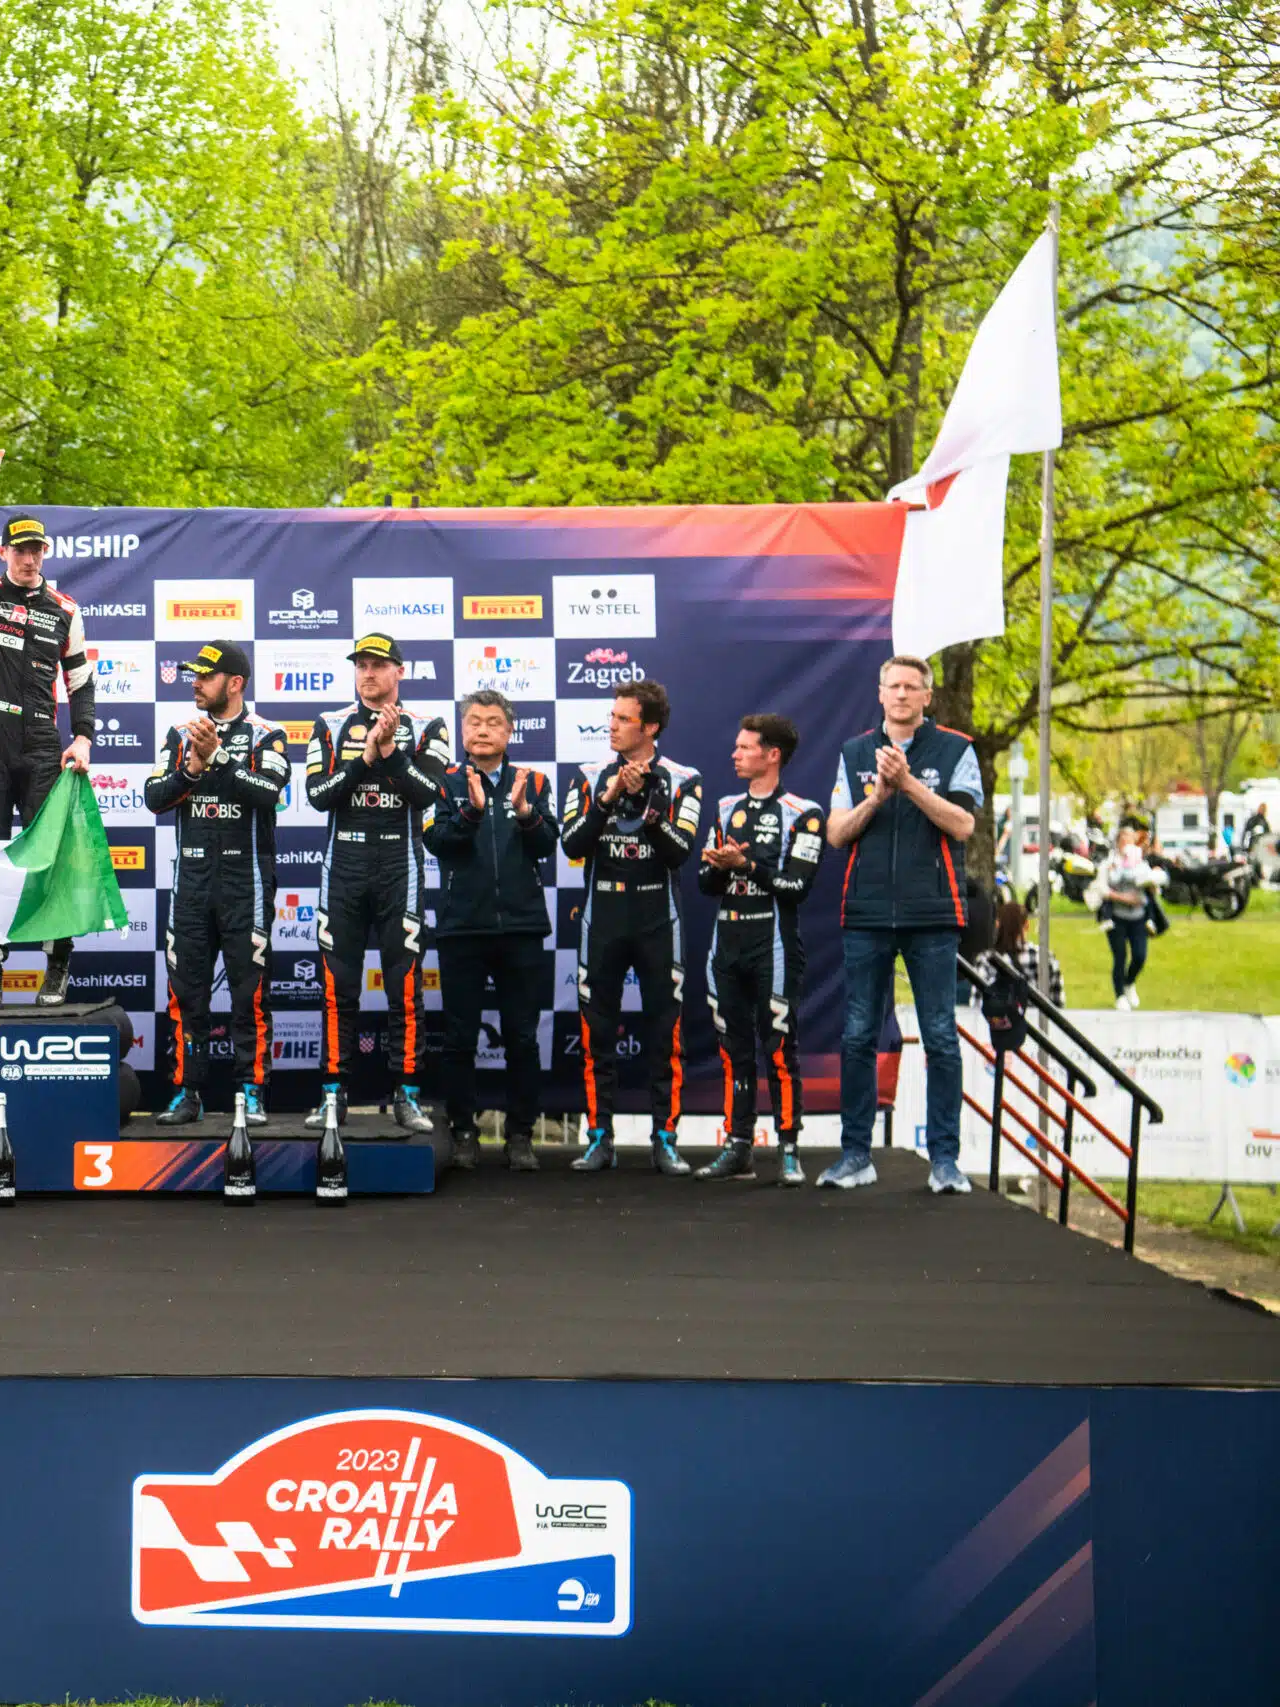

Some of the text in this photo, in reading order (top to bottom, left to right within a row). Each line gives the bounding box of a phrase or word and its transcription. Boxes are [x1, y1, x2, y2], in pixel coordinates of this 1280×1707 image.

[28, 608, 60, 621] TOYOTA
[78, 604, 146, 617] sahiKASEI
[173, 603, 237, 618] PIRELLI
[365, 603, 444, 616] AsahiKASEI
[471, 600, 535, 616] PIRELLI
[569, 603, 640, 615] TW STEEL
[28, 614, 57, 626] GAZOO
[28, 619, 55, 632] Racing
[295, 672, 334, 691] HEP
[567, 662, 646, 689] Zagreb
[519, 717, 546, 730] FUELS
[96, 735, 142, 747] STEEL
[97, 789, 144, 812] greb
[351, 792, 403, 808] MOBIS
[191, 803, 242, 819] MOBIS
[598, 835, 639, 844] HYUNDAI
[276, 850, 324, 864] sahiKA
[609, 843, 654, 859] MOBI
[67, 974, 147, 987] AsahiKASEI
[0, 1035, 111, 1061] WRC
[294, 1041, 319, 1059] HE
[82, 1145, 114, 1187] 3
[336, 1449, 400, 1472] 2023
[266, 1478, 458, 1517] CROATIA
[536, 1503, 607, 1519] WRC
[319, 1519, 454, 1553] RALLY
